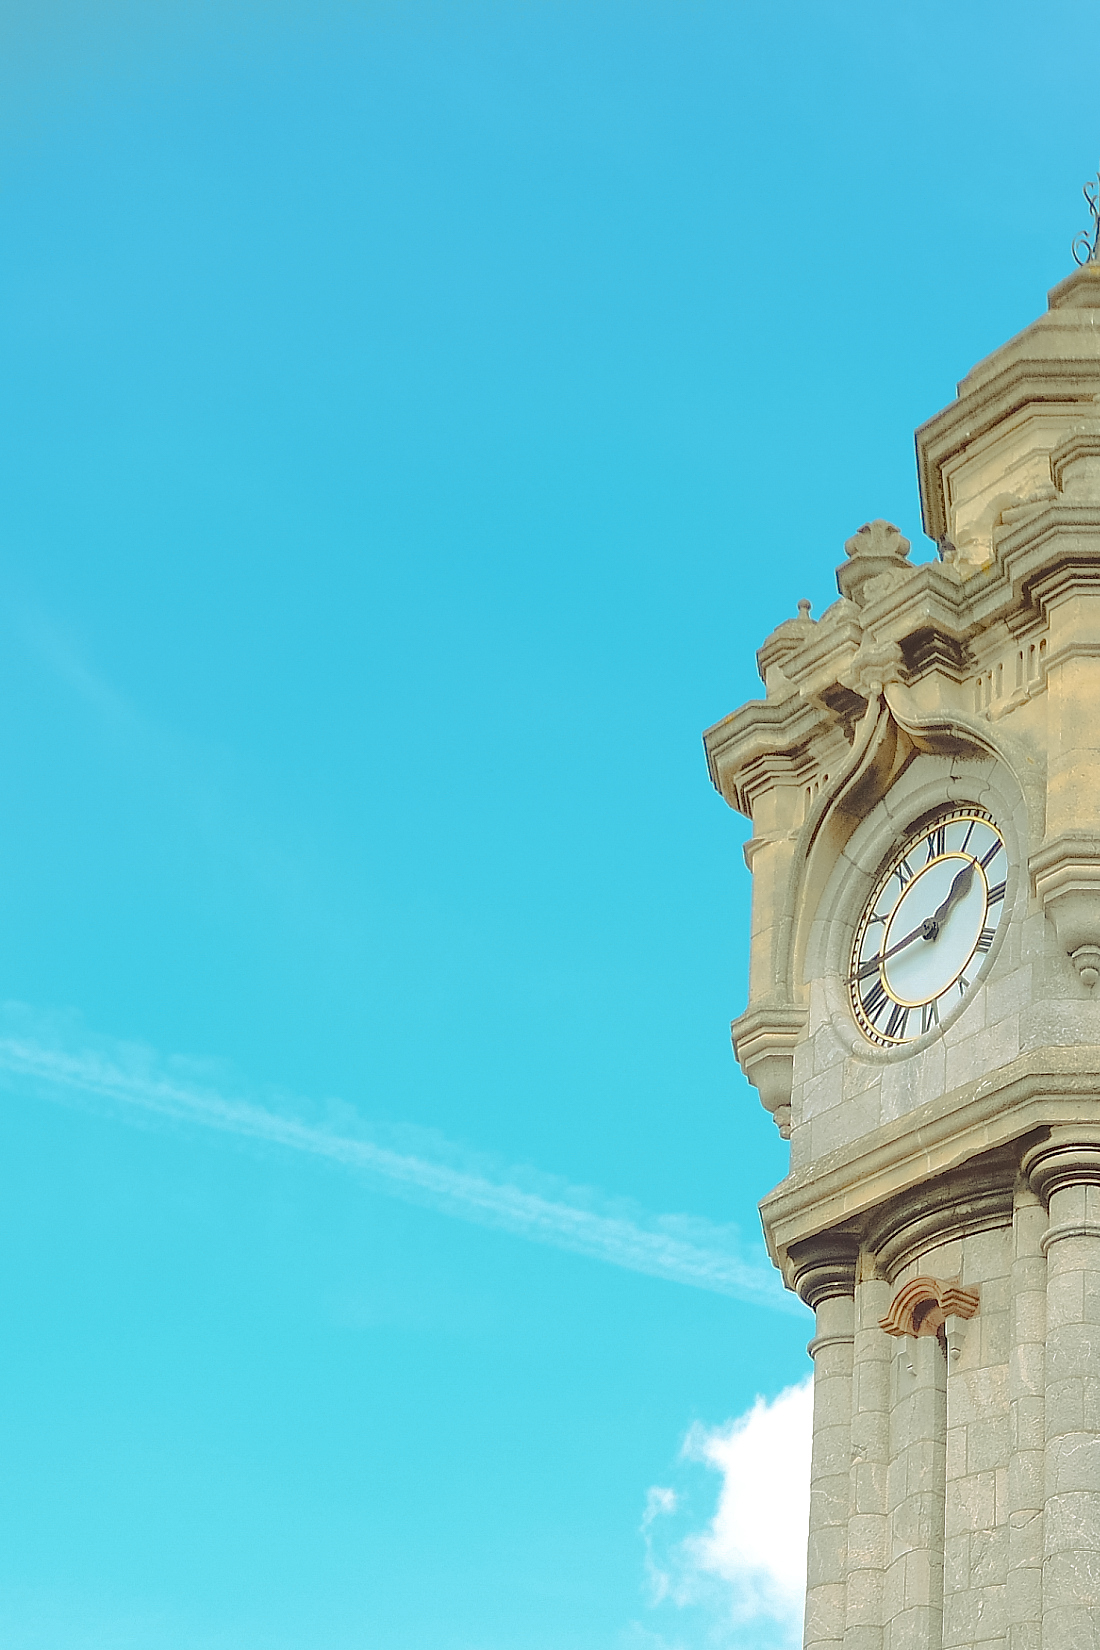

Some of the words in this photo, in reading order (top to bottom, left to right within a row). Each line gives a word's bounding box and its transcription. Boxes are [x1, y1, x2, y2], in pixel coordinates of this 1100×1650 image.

[926, 826, 946, 865] XII
[961, 820, 976, 853] I
[980, 838, 1003, 869] II
[894, 858, 915, 892] XI
[987, 881, 1007, 908] III
[868, 910, 889, 926] X
[862, 979, 889, 1026] VIII
[921, 999, 940, 1035] VI
[884, 1003, 910, 1039] VII
